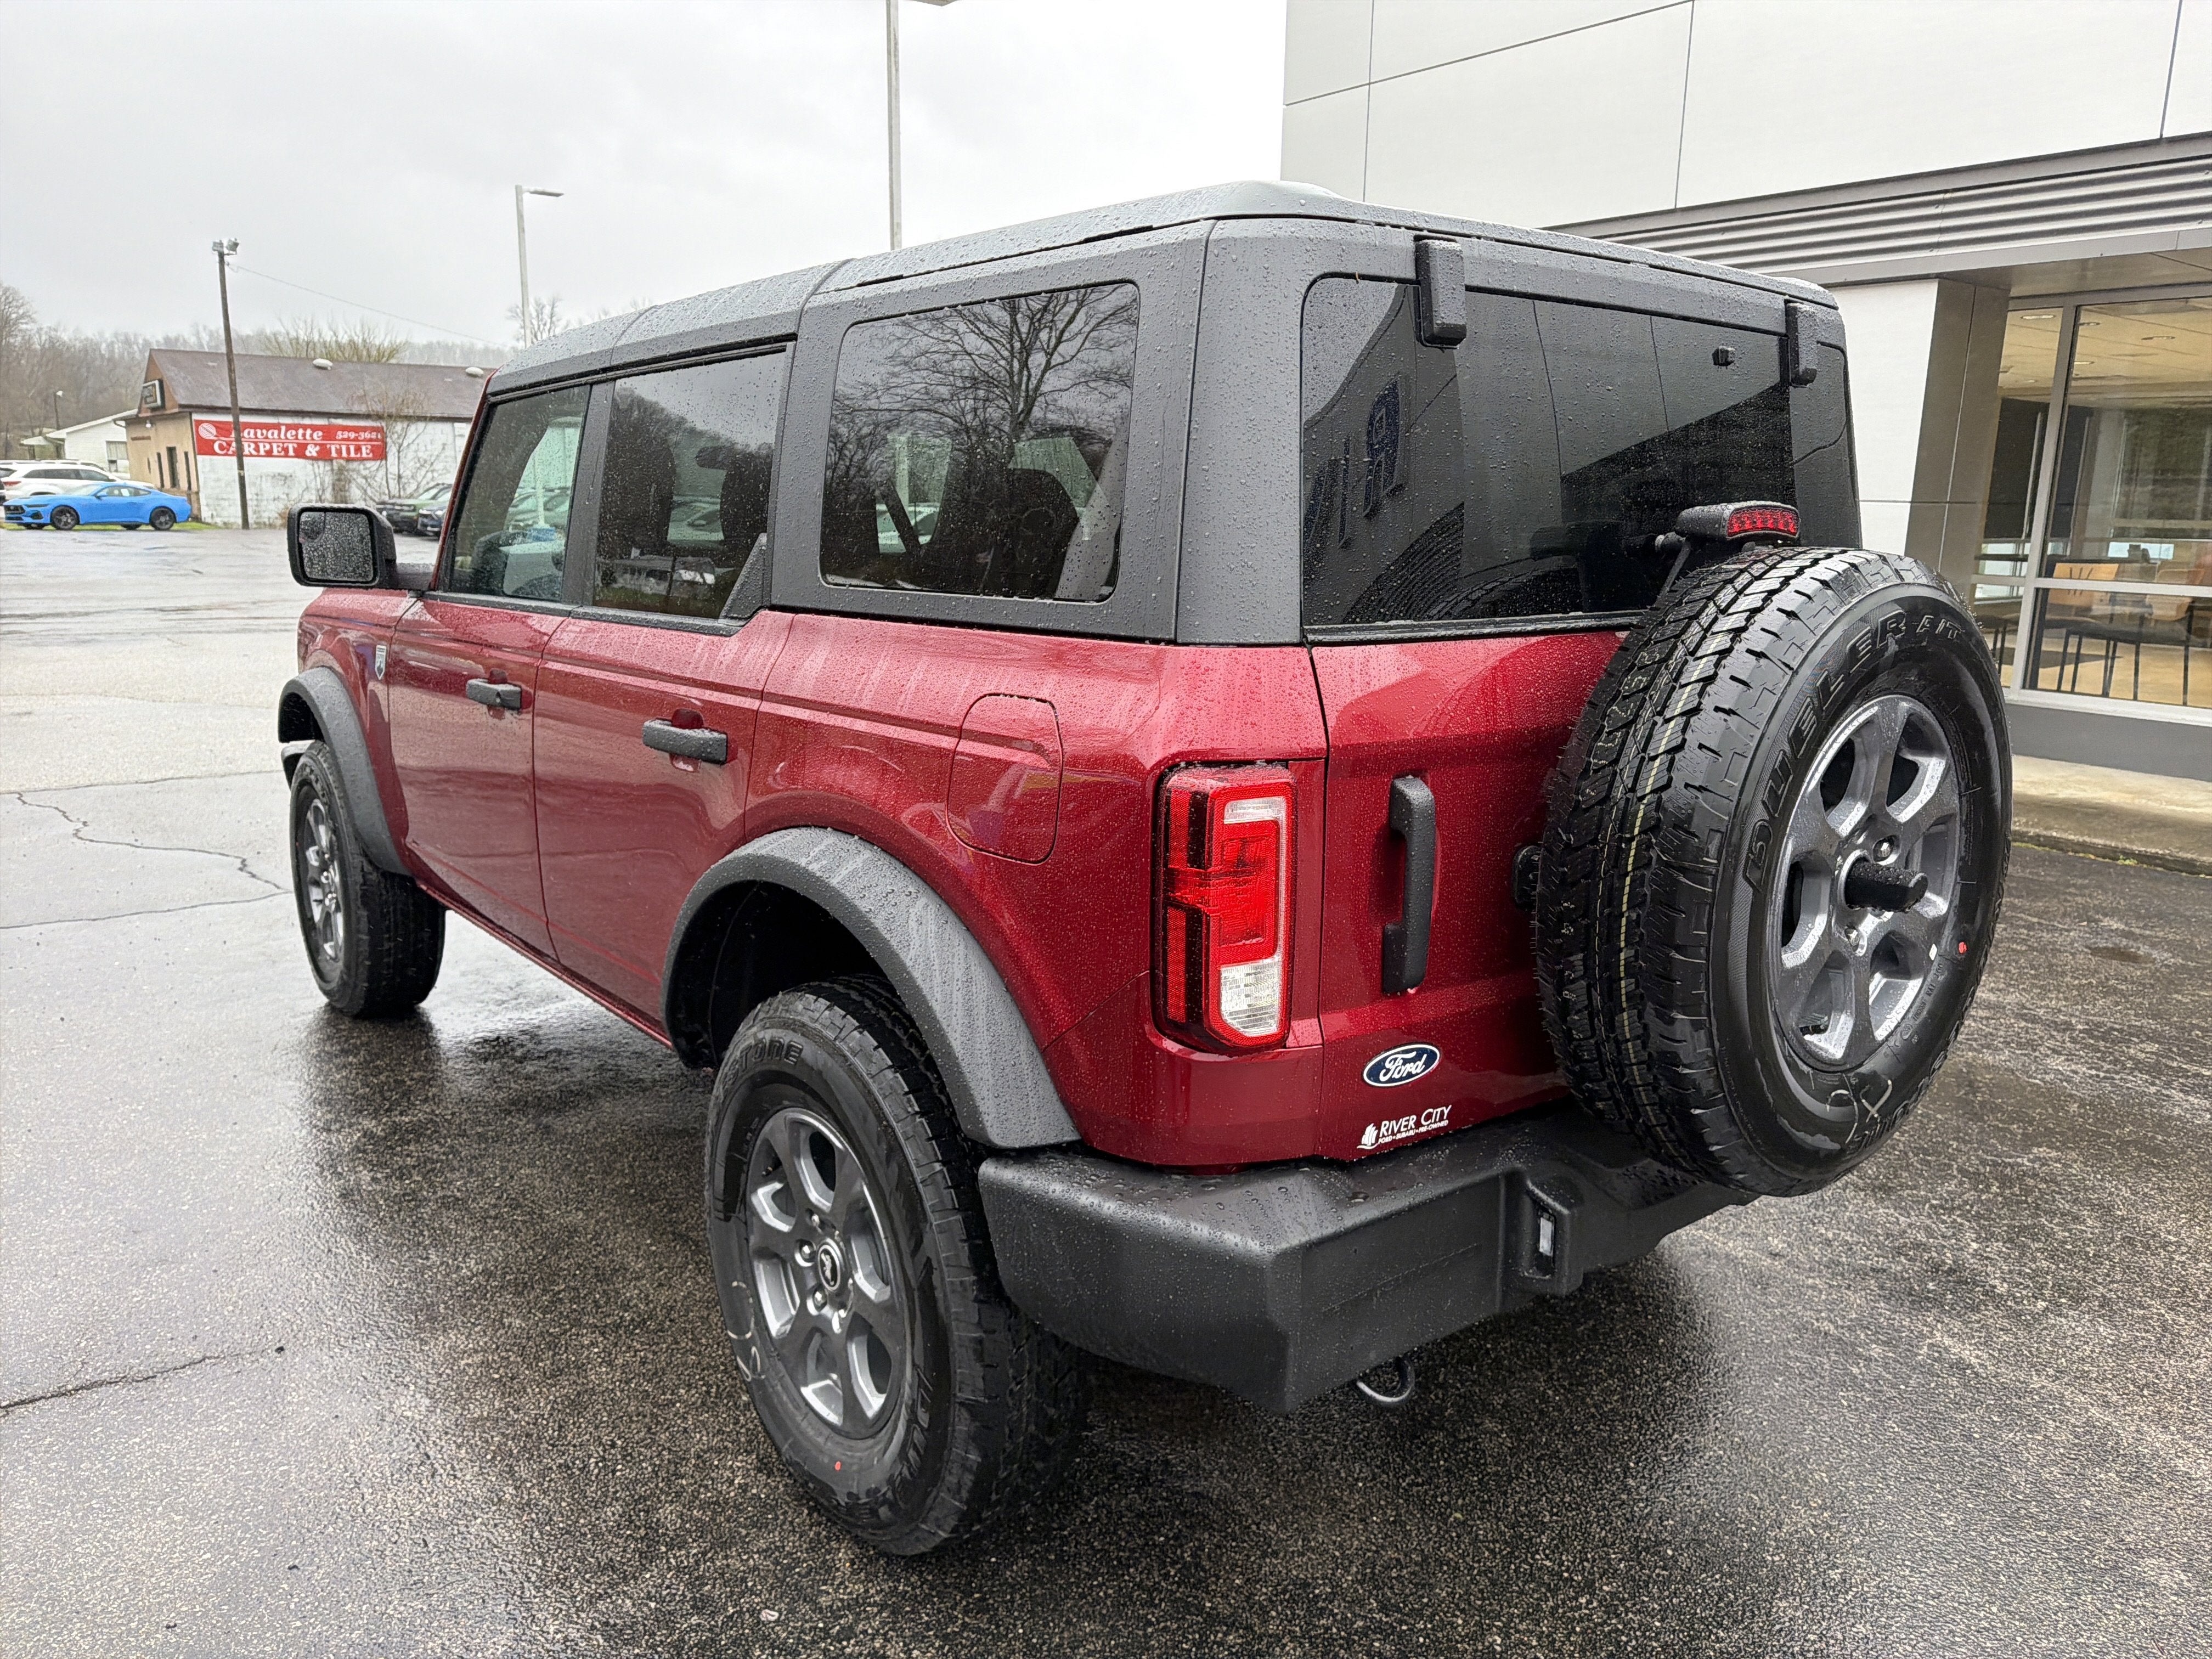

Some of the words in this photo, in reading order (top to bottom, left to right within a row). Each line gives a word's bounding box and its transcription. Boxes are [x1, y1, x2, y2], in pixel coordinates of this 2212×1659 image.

[213, 440, 298, 456] CARPET
[305, 443, 320, 457] &
[326, 444, 373, 458] TILE
[1379, 1051, 1427, 1082] Ford
[1379, 1115, 1417, 1137] RIVER
[1421, 1104, 1452, 1125] CITY
[1378, 1135, 1393, 1144] FORD
[1396, 1128, 1416, 1139] SUBARU
